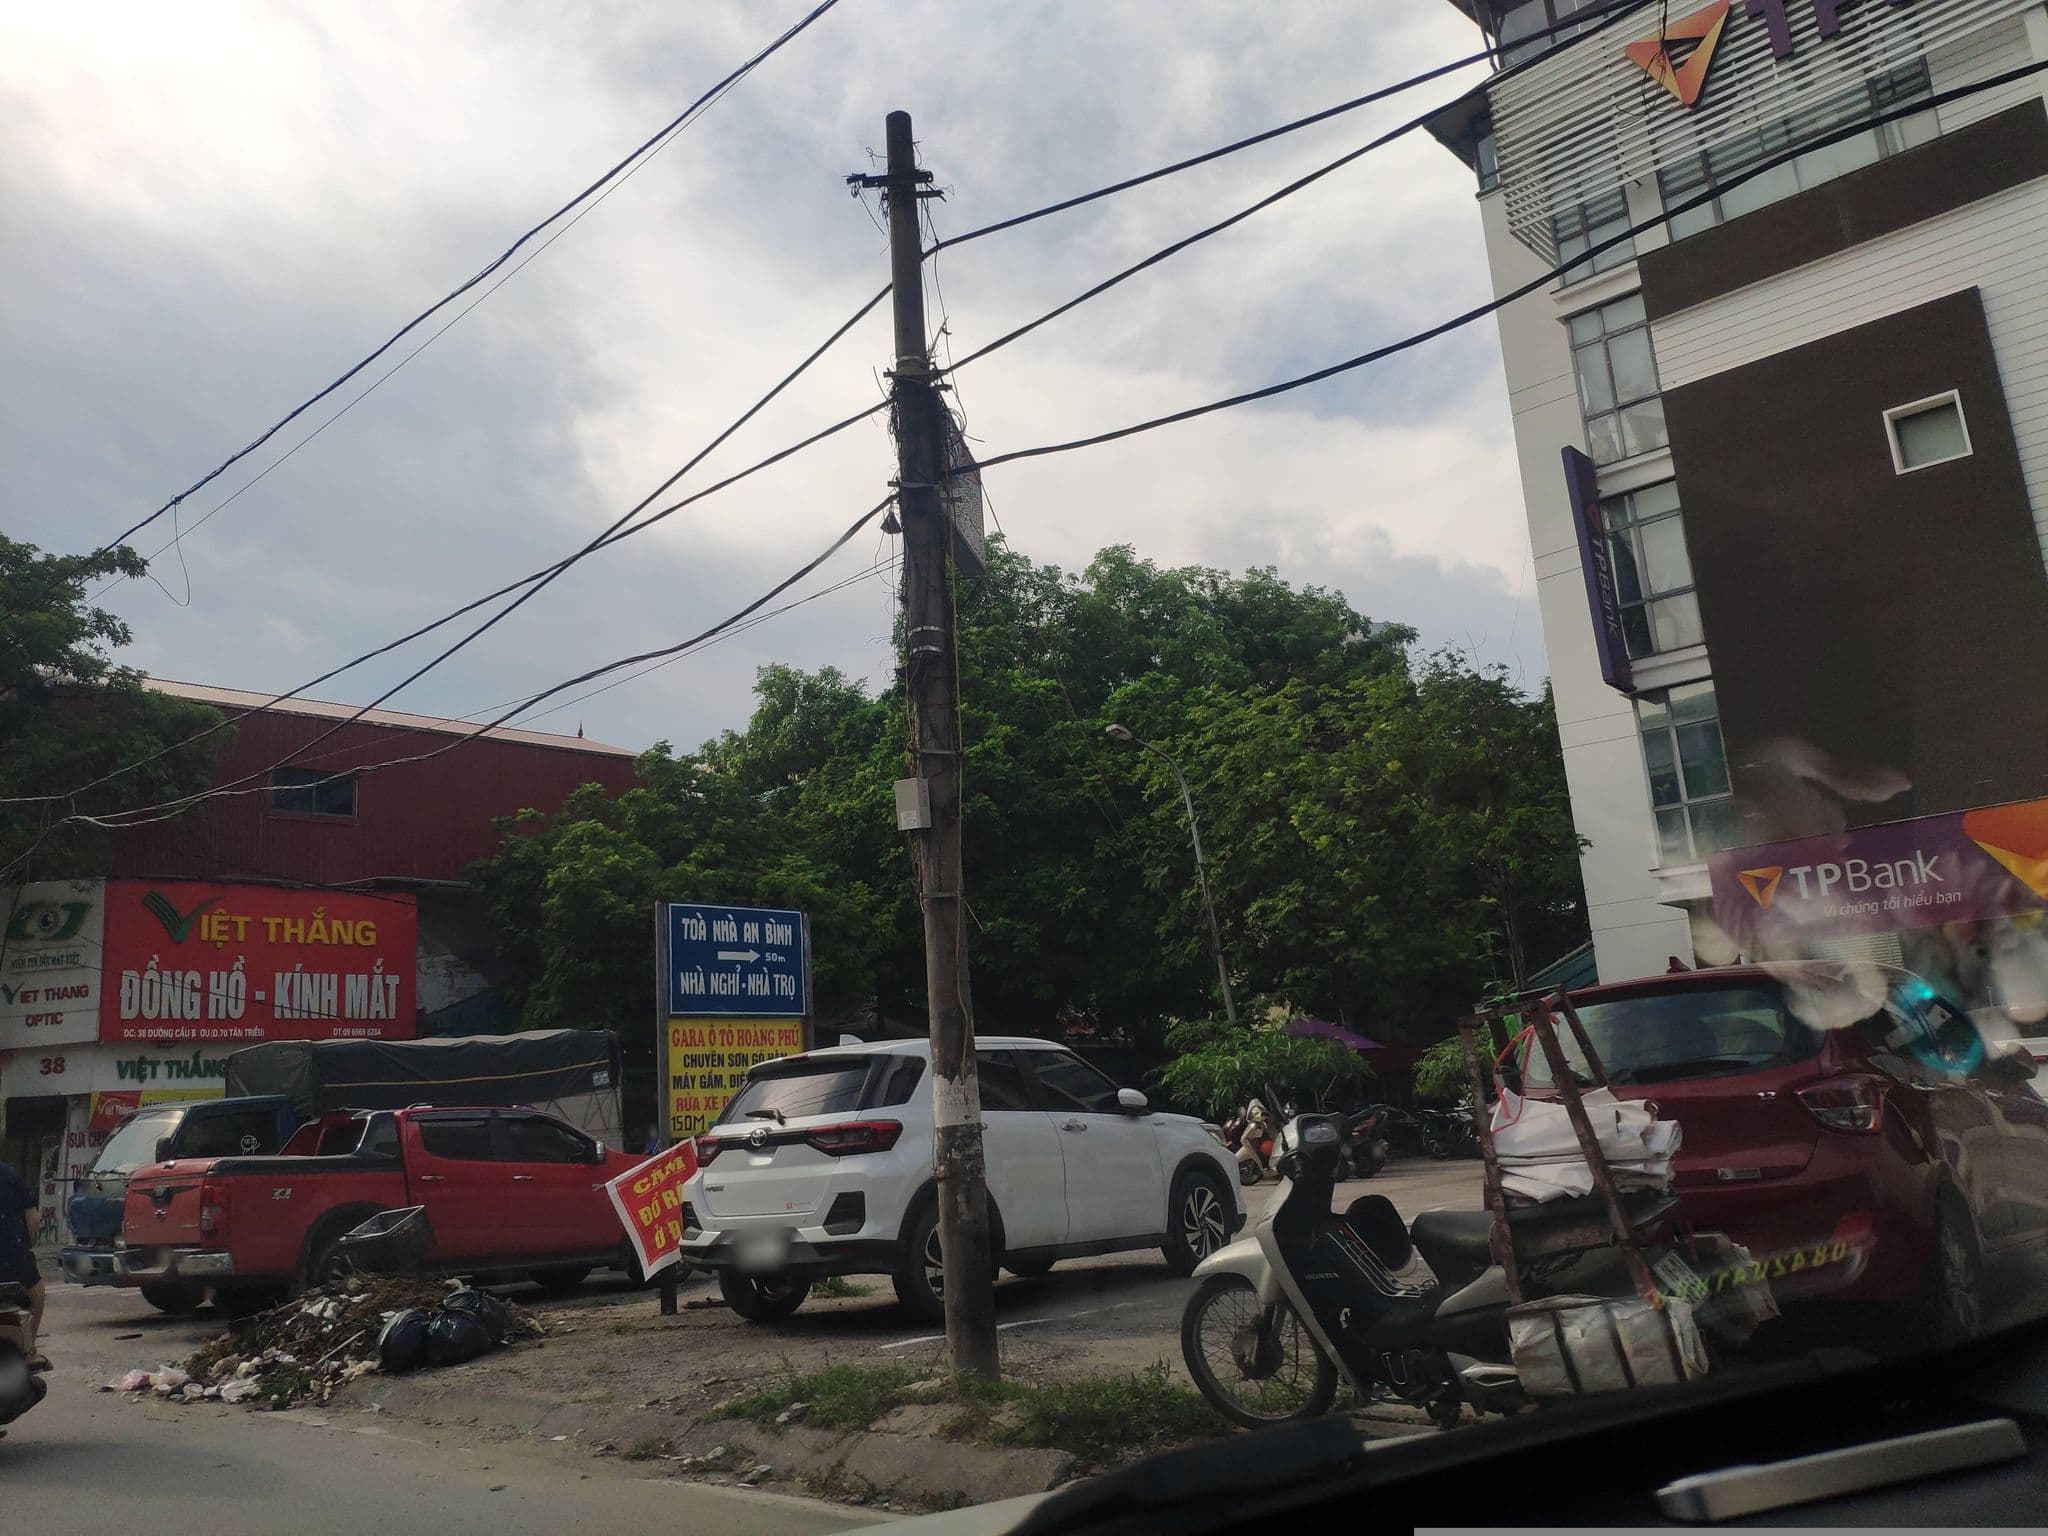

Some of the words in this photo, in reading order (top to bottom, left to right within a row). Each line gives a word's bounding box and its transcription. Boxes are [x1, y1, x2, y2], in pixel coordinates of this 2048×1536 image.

[1592, 537, 1618, 638] TPBank
[1789, 850, 1944, 899] TPBank
[1840, 900, 1879, 916] chúng
[1883, 896, 1900, 910] tôi
[1904, 890, 1932, 908] hiểu
[1936, 890, 1961, 905] bạn
[263, 905, 377, 946] THẮNG
[682, 912, 707, 941] TOÀ
[712, 914, 738, 942] NHÀ
[743, 922, 759, 943] AN
[765, 918, 792, 946] BÌNH
[765, 952, 786, 963] 50m
[44, 985, 89, 1002] THANG
[120, 954, 201, 1020] ĐỒNG
[208, 955, 246, 1020] HỒ
[275, 963, 338, 1019] KÍNH
[345, 957, 400, 1019] MẮT
[680, 965, 705, 995] NHÀ
[710, 964, 740, 995] NGHỈ
[748, 967, 770, 995] NHÀ
[773, 974, 796, 1000] TRỌ
[25, 1012, 64, 1028] OPTIC
[672, 1028, 706, 1047] GARA
[708, 1024, 716, 1047] Ô
[719, 1024, 734, 1047] TÔ
[737, 1024, 776, 1047] HOÀNG
[778, 1025, 800, 1047] PHÚ
[40, 1057, 66, 1075] 38
[116, 1056, 161, 1083] VIỆT
[683, 1050, 725, 1068] CHUYÊN
[673, 1072, 697, 1089] MÁY
[676, 1092, 700, 1112] RỬA
[704, 1096, 719, 1110] XE
